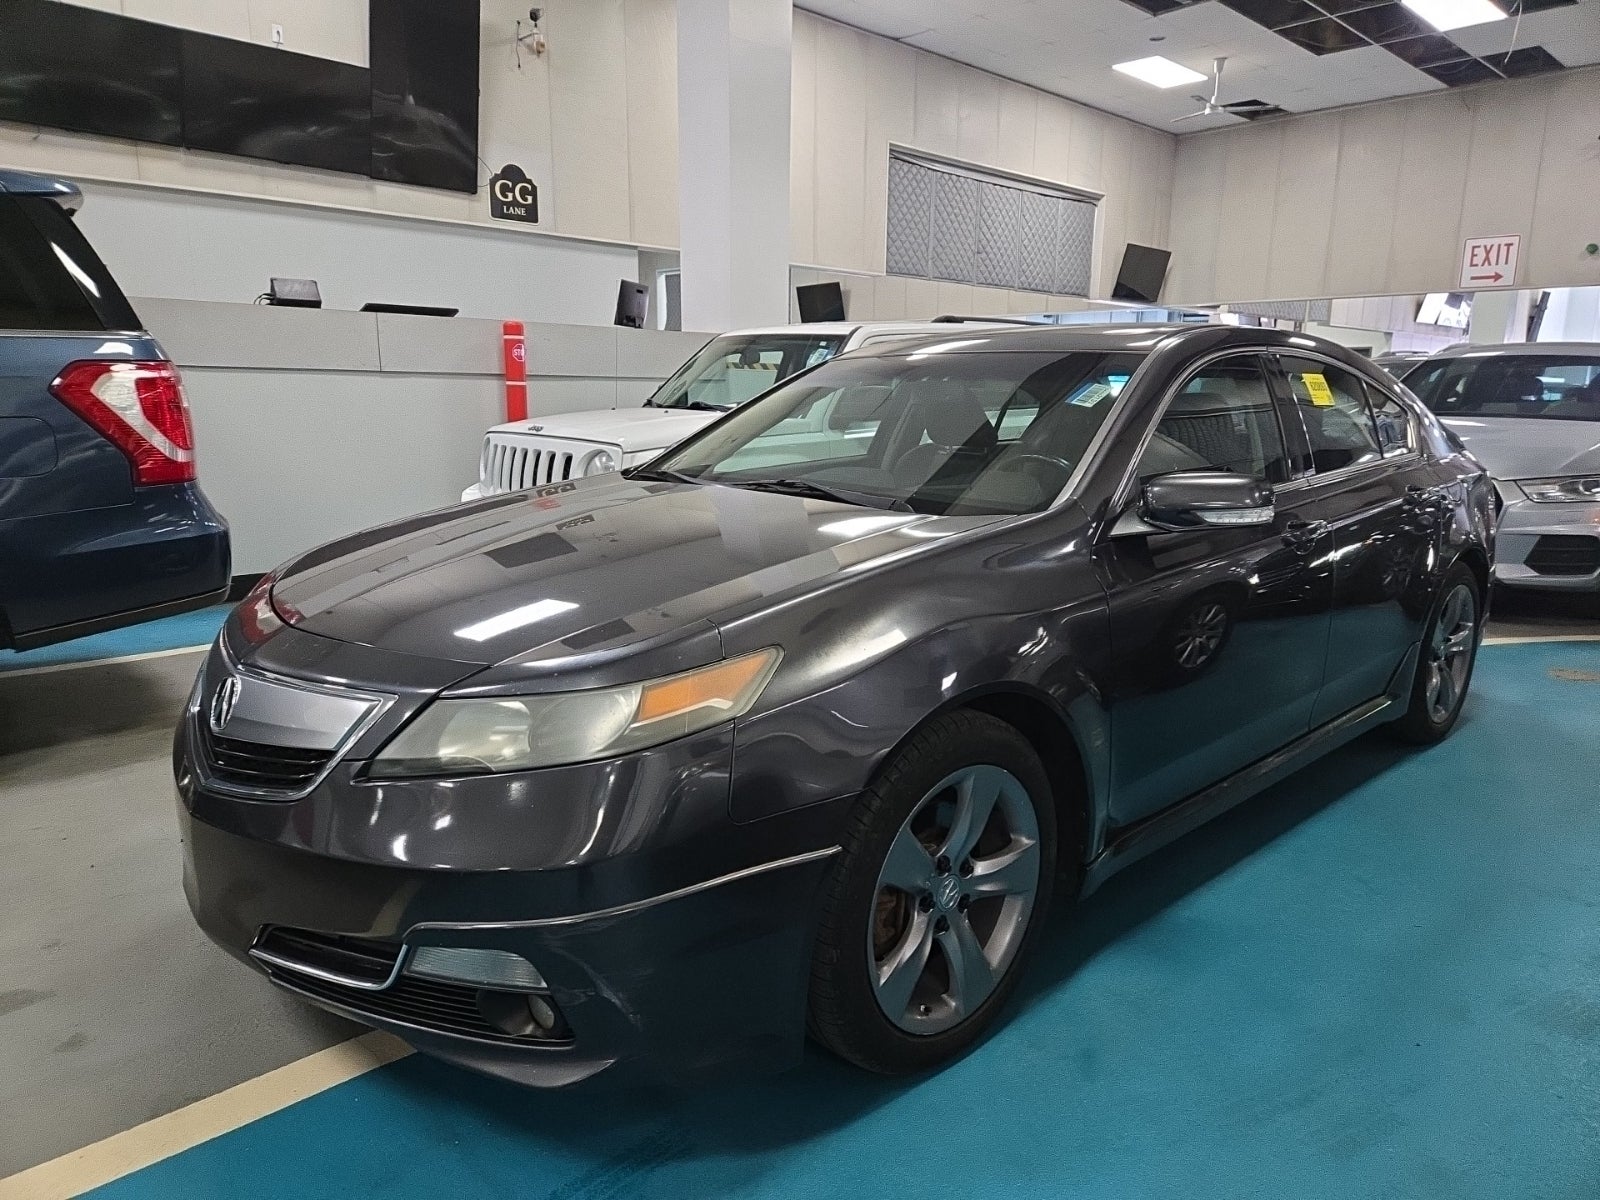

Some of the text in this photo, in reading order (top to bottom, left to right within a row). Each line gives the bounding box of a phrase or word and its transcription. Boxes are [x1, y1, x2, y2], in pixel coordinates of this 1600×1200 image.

[495, 180, 533, 204] GG
[503, 206, 527, 216] LANE
[1470, 242, 1514, 267] EXIT
